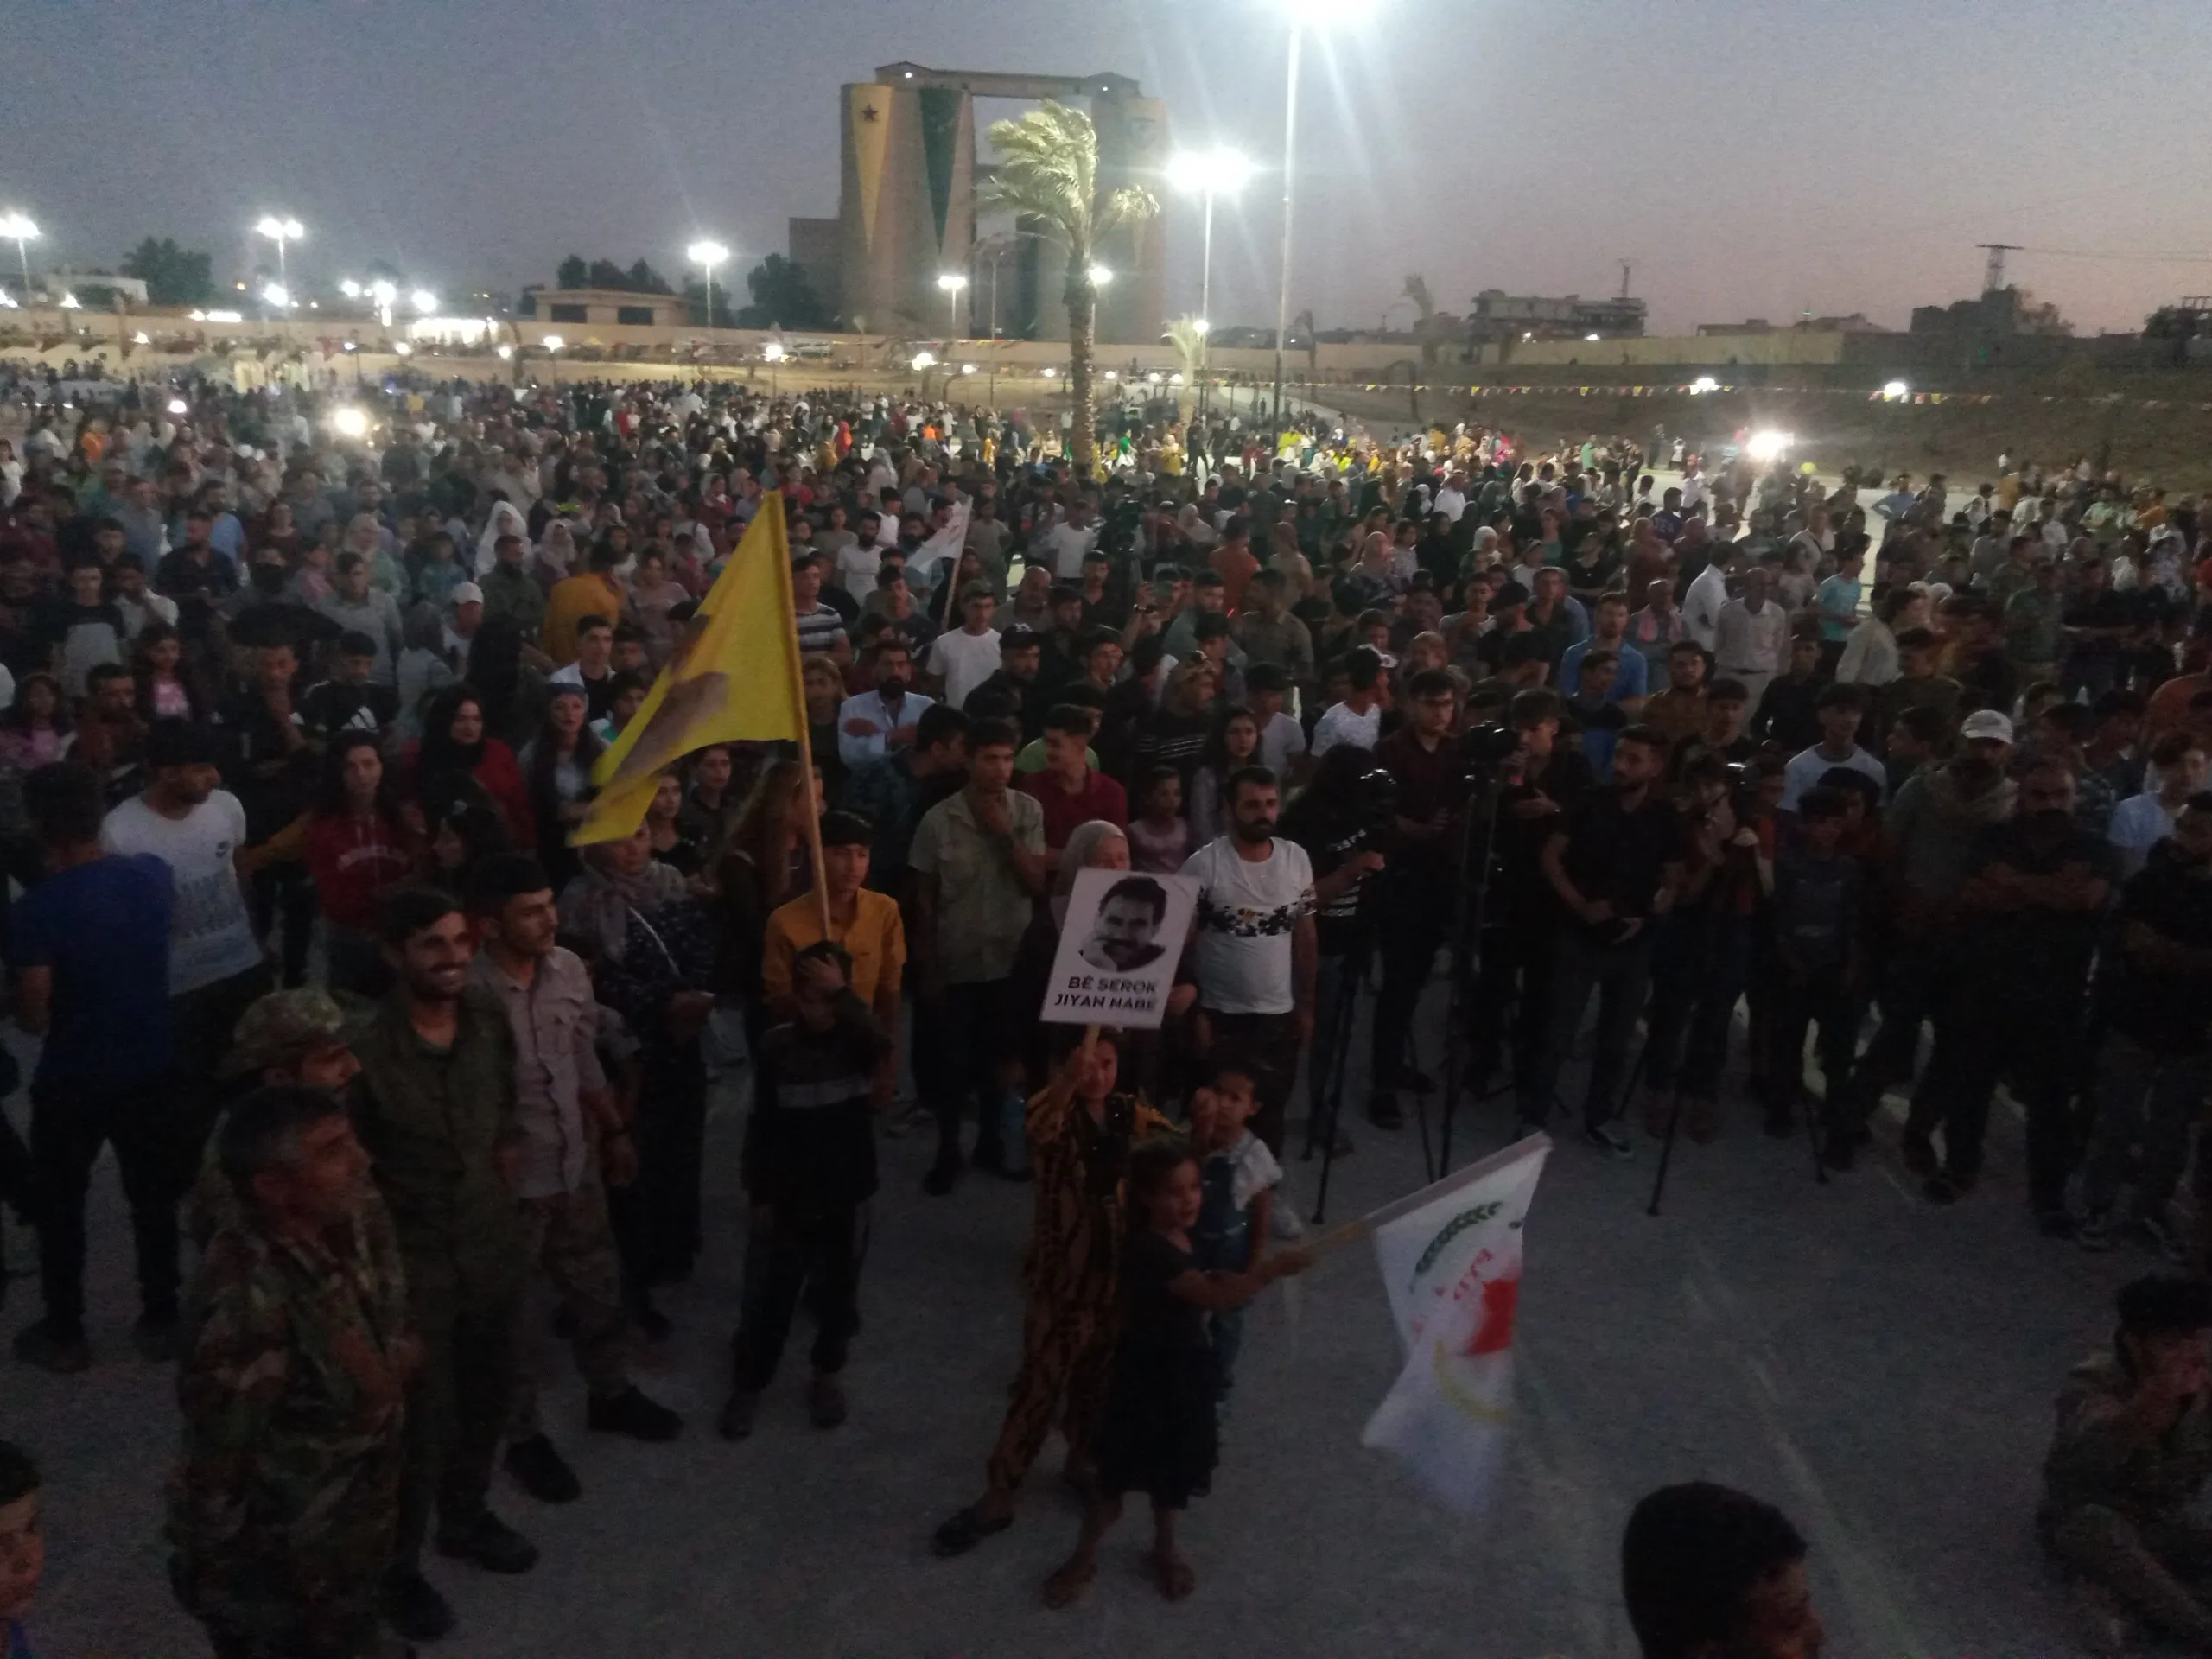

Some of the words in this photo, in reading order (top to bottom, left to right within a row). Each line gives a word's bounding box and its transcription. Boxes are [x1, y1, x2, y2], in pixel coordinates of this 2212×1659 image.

[1068, 975, 1094, 989] BÊ
[1097, 978, 1156, 994] SEROK
[1054, 994, 1105, 1007] JIYAN
